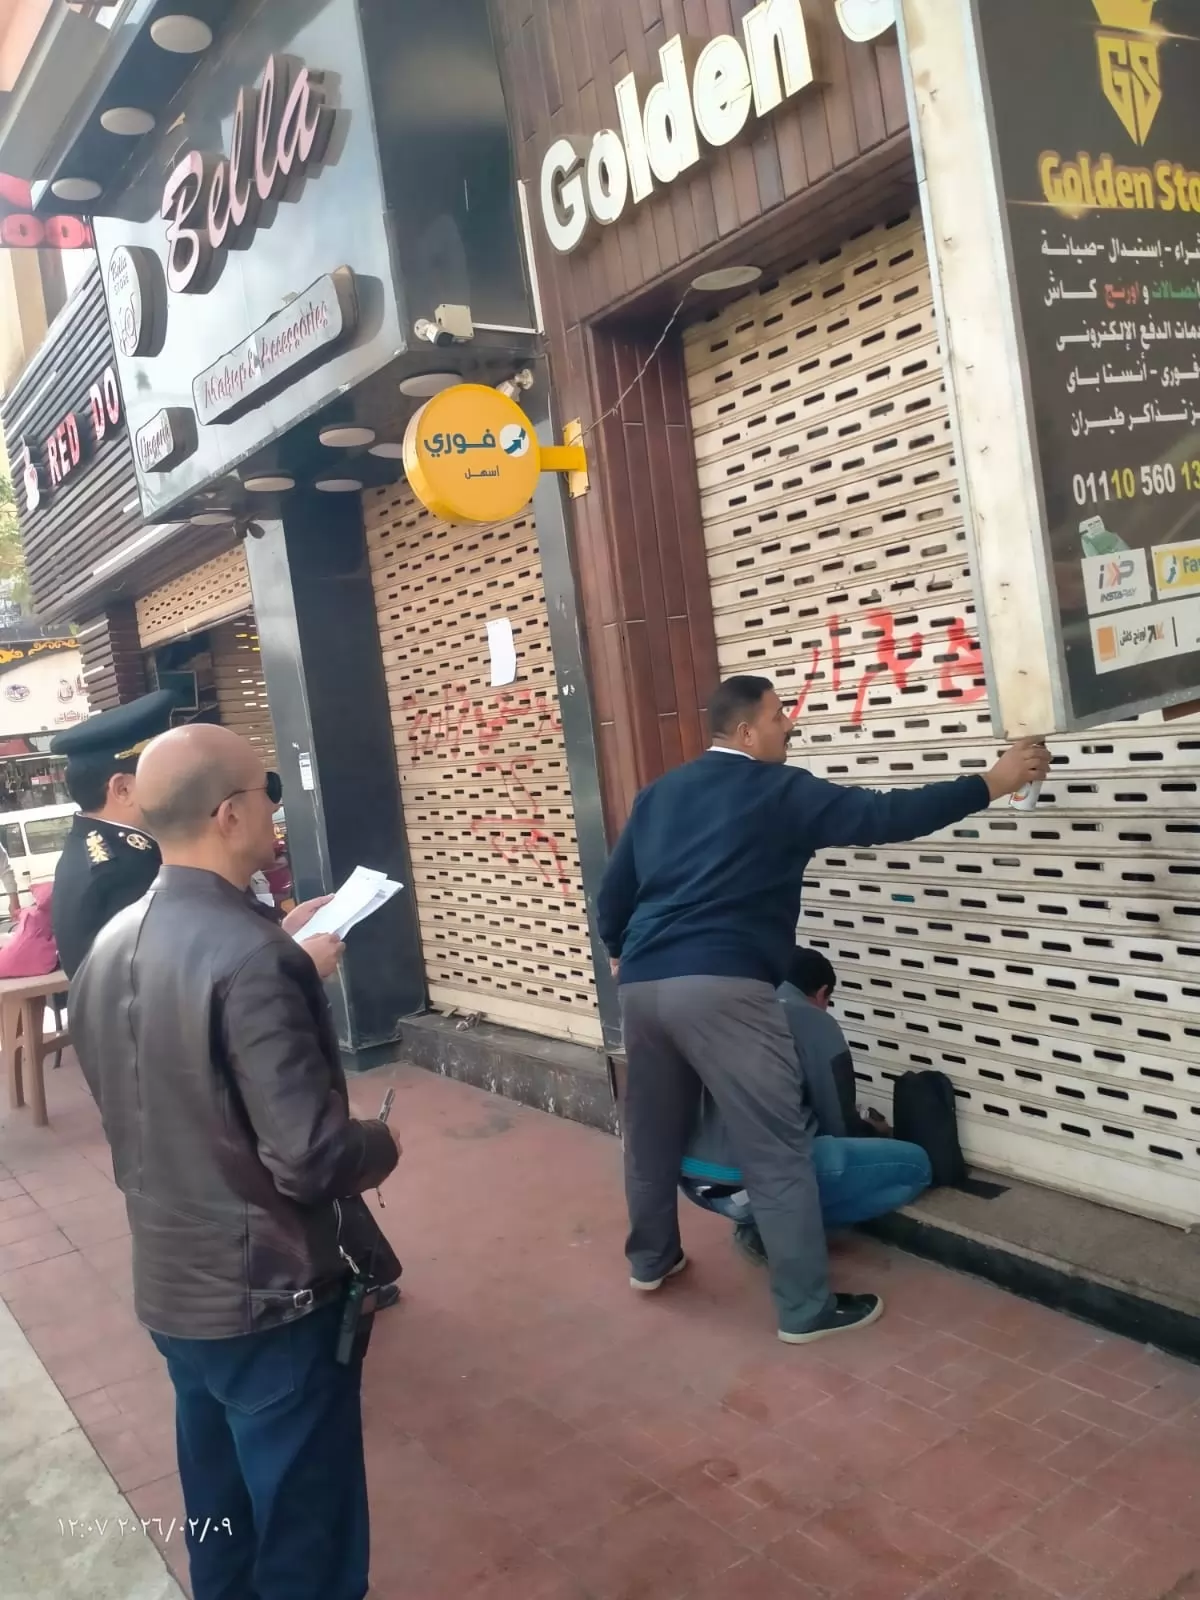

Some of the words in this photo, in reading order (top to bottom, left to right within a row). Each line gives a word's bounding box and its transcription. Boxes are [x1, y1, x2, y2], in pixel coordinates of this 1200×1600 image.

[541, 0, 814, 255] Golden
[161, 53, 322, 293] Bella
[1040, 157, 1154, 209] Golden
[1044, 269, 1097, 307] كاش
[1140, 313, 1171, 350] الدفع
[47, 411, 81, 488] RED
[89, 366, 120, 441] DO
[424, 429, 496, 457] فوري
[1072, 468, 1136, 505] 01110
[1140, 463, 1176, 496] 560
